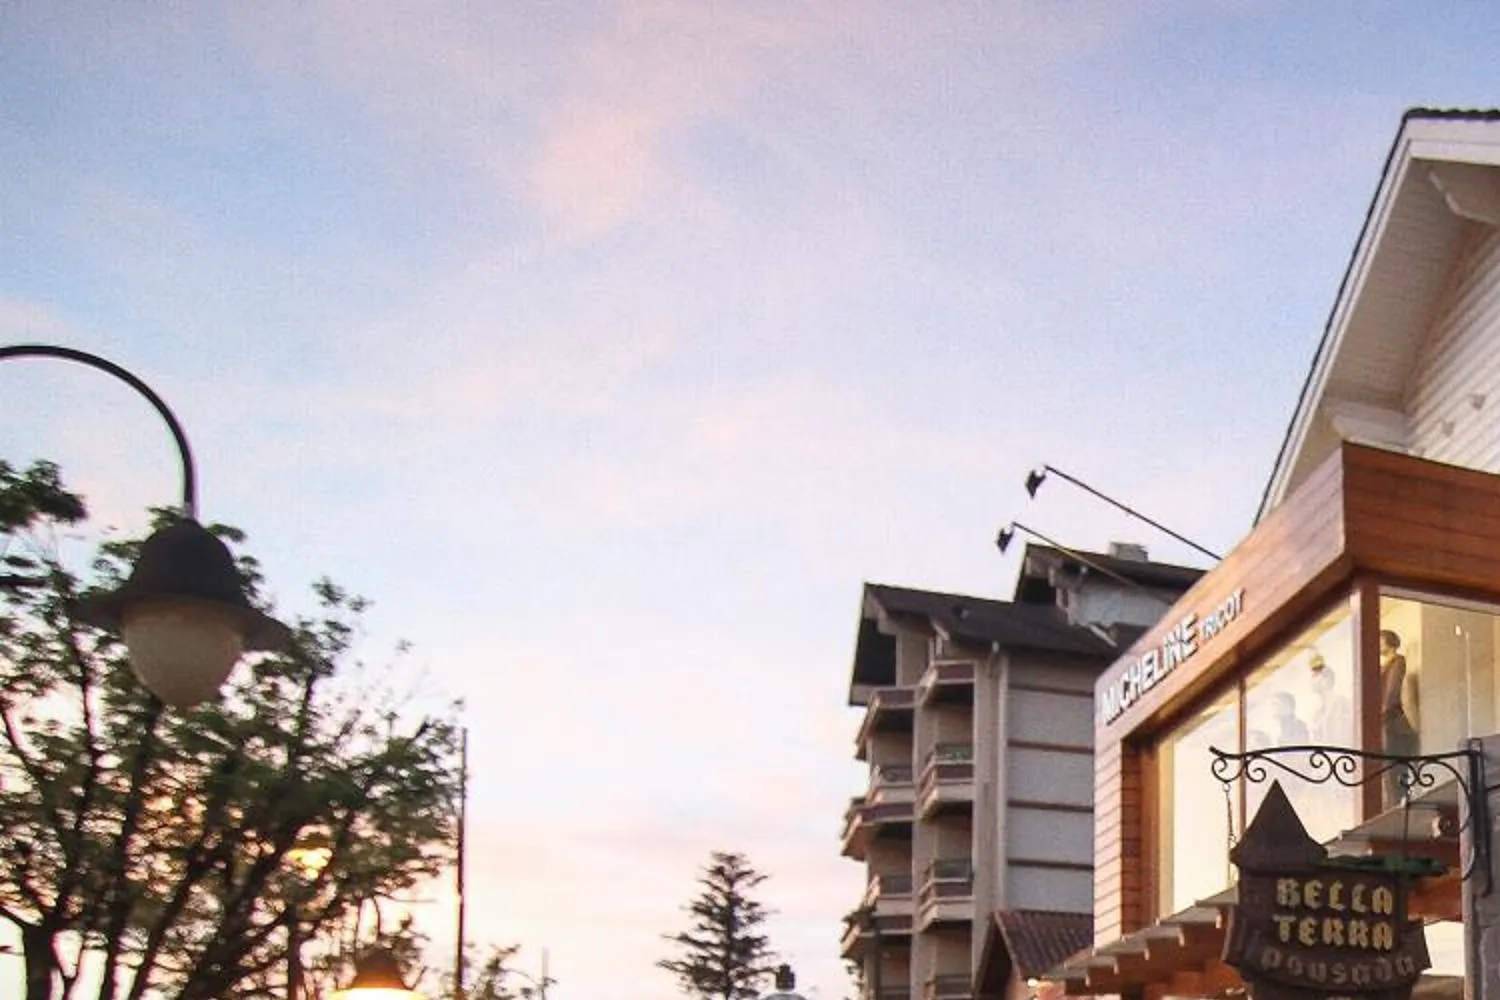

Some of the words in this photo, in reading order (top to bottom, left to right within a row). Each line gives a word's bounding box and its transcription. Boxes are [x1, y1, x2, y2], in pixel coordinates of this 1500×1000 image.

[1102, 613, 1199, 726] MICHELINE
[1275, 877, 1394, 916] BELLA
[1272, 914, 1394, 951] TERRA
